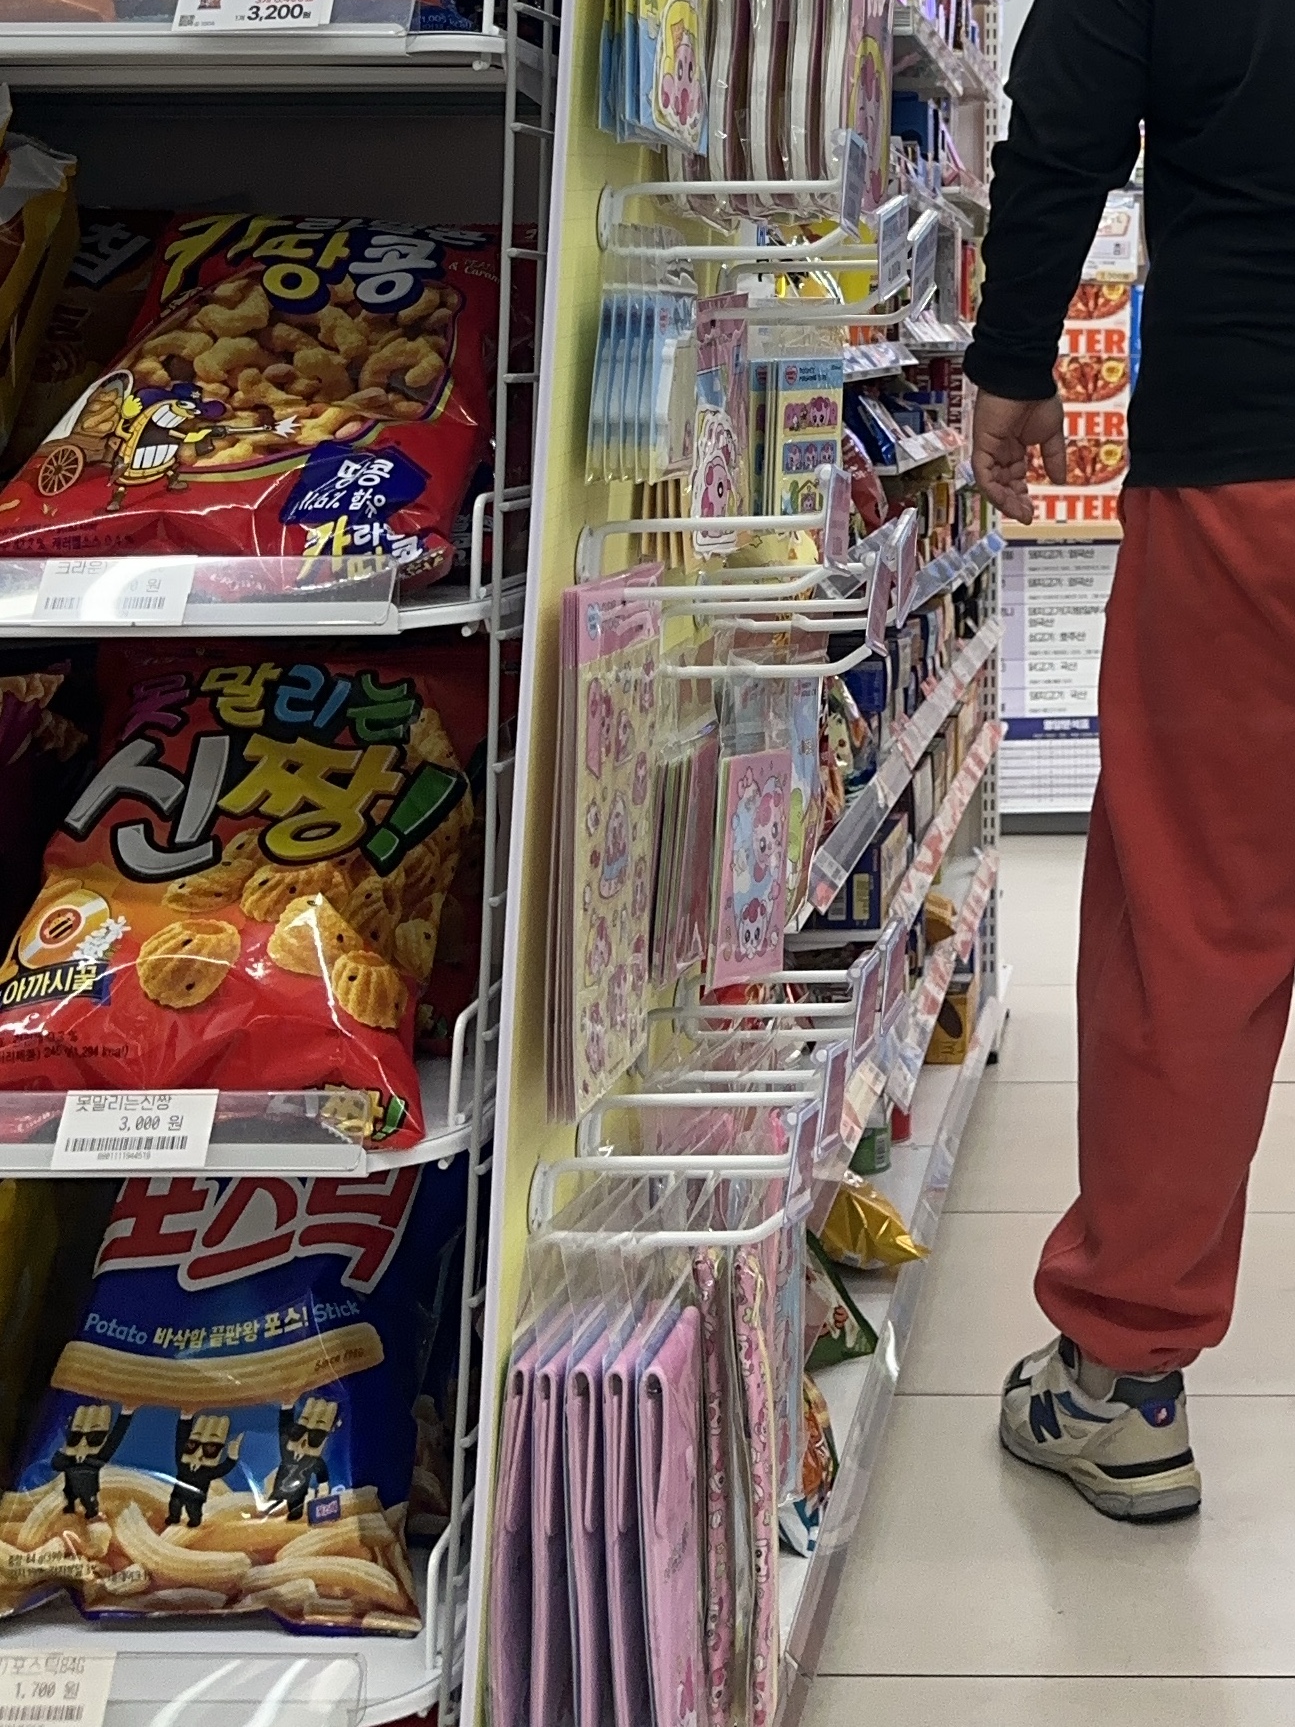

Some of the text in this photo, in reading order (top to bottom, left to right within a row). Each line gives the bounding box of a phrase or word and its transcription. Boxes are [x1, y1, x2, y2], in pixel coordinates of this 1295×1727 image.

[1064, 329, 1126, 354] TER
[1063, 411, 1126, 437] TER
[337, 458, 396, 489] 땅콩
[123, 662, 422, 743] 못말리는
[64, 734, 465, 880] 신짱!
[2, 964, 98, 1005] 아까시꿀
[75, 1095, 173, 1113] 못말리는신짱
[118, 1114, 185, 1132] 3,000 원
[83, 1312, 148, 1346] Potato
[263, 1305, 310, 1338] 포스!
[312, 1299, 361, 1324] Stick
